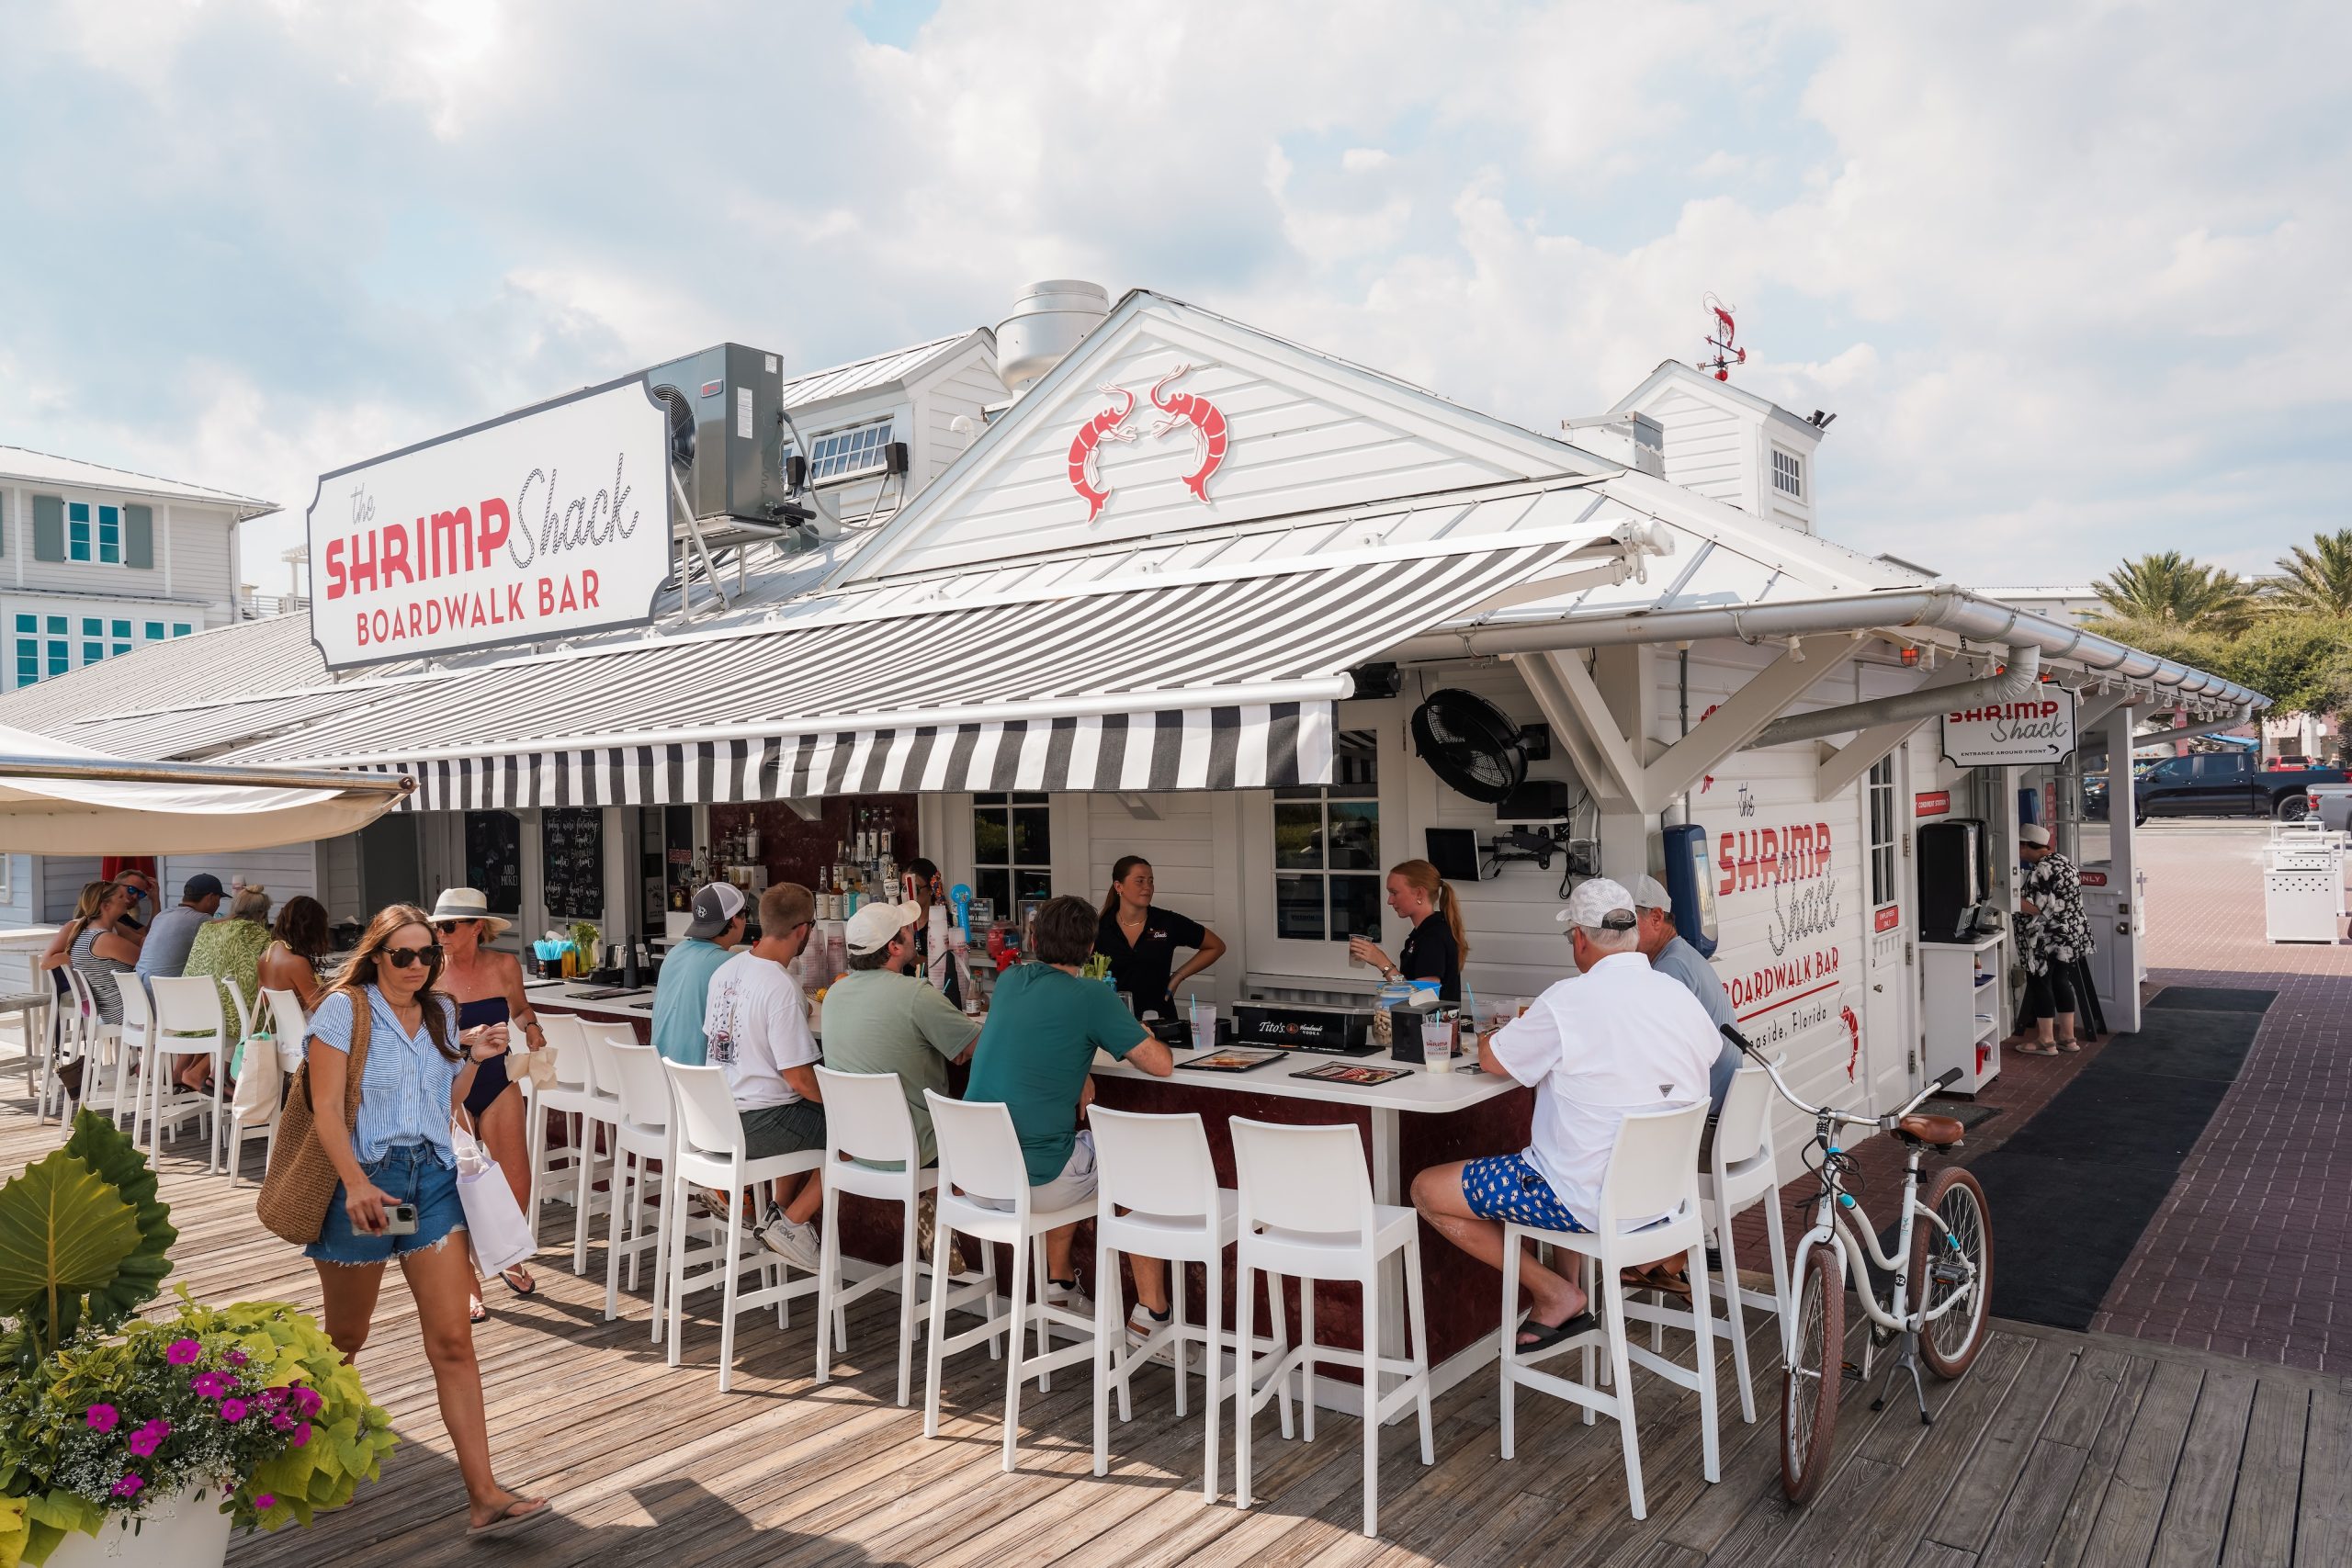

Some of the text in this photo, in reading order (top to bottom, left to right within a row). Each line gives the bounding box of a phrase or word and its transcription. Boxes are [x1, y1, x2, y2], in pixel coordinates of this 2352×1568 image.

[350, 482, 376, 525] the
[326, 452, 639, 601] SHRIMP Shack
[356, 569, 600, 647] BOARDWALK BAR
[1950, 700, 2059, 724] SHRIMP
[1990, 712, 2068, 743] Shack
[1738, 782, 1755, 818] the
[1917, 800, 1935, 808] CONDIMENT
[503, 864, 515, 875] AND
[1718, 822, 1832, 897] SHRIMP
[1769, 851, 1839, 956] Shack
[1879, 910, 1894, 919] EMPLOYEES
[1815, 946, 1838, 978] BAR
[1259, 1021, 1285, 1033] Tito's
[1792, 1001, 1826, 1032] Florida
